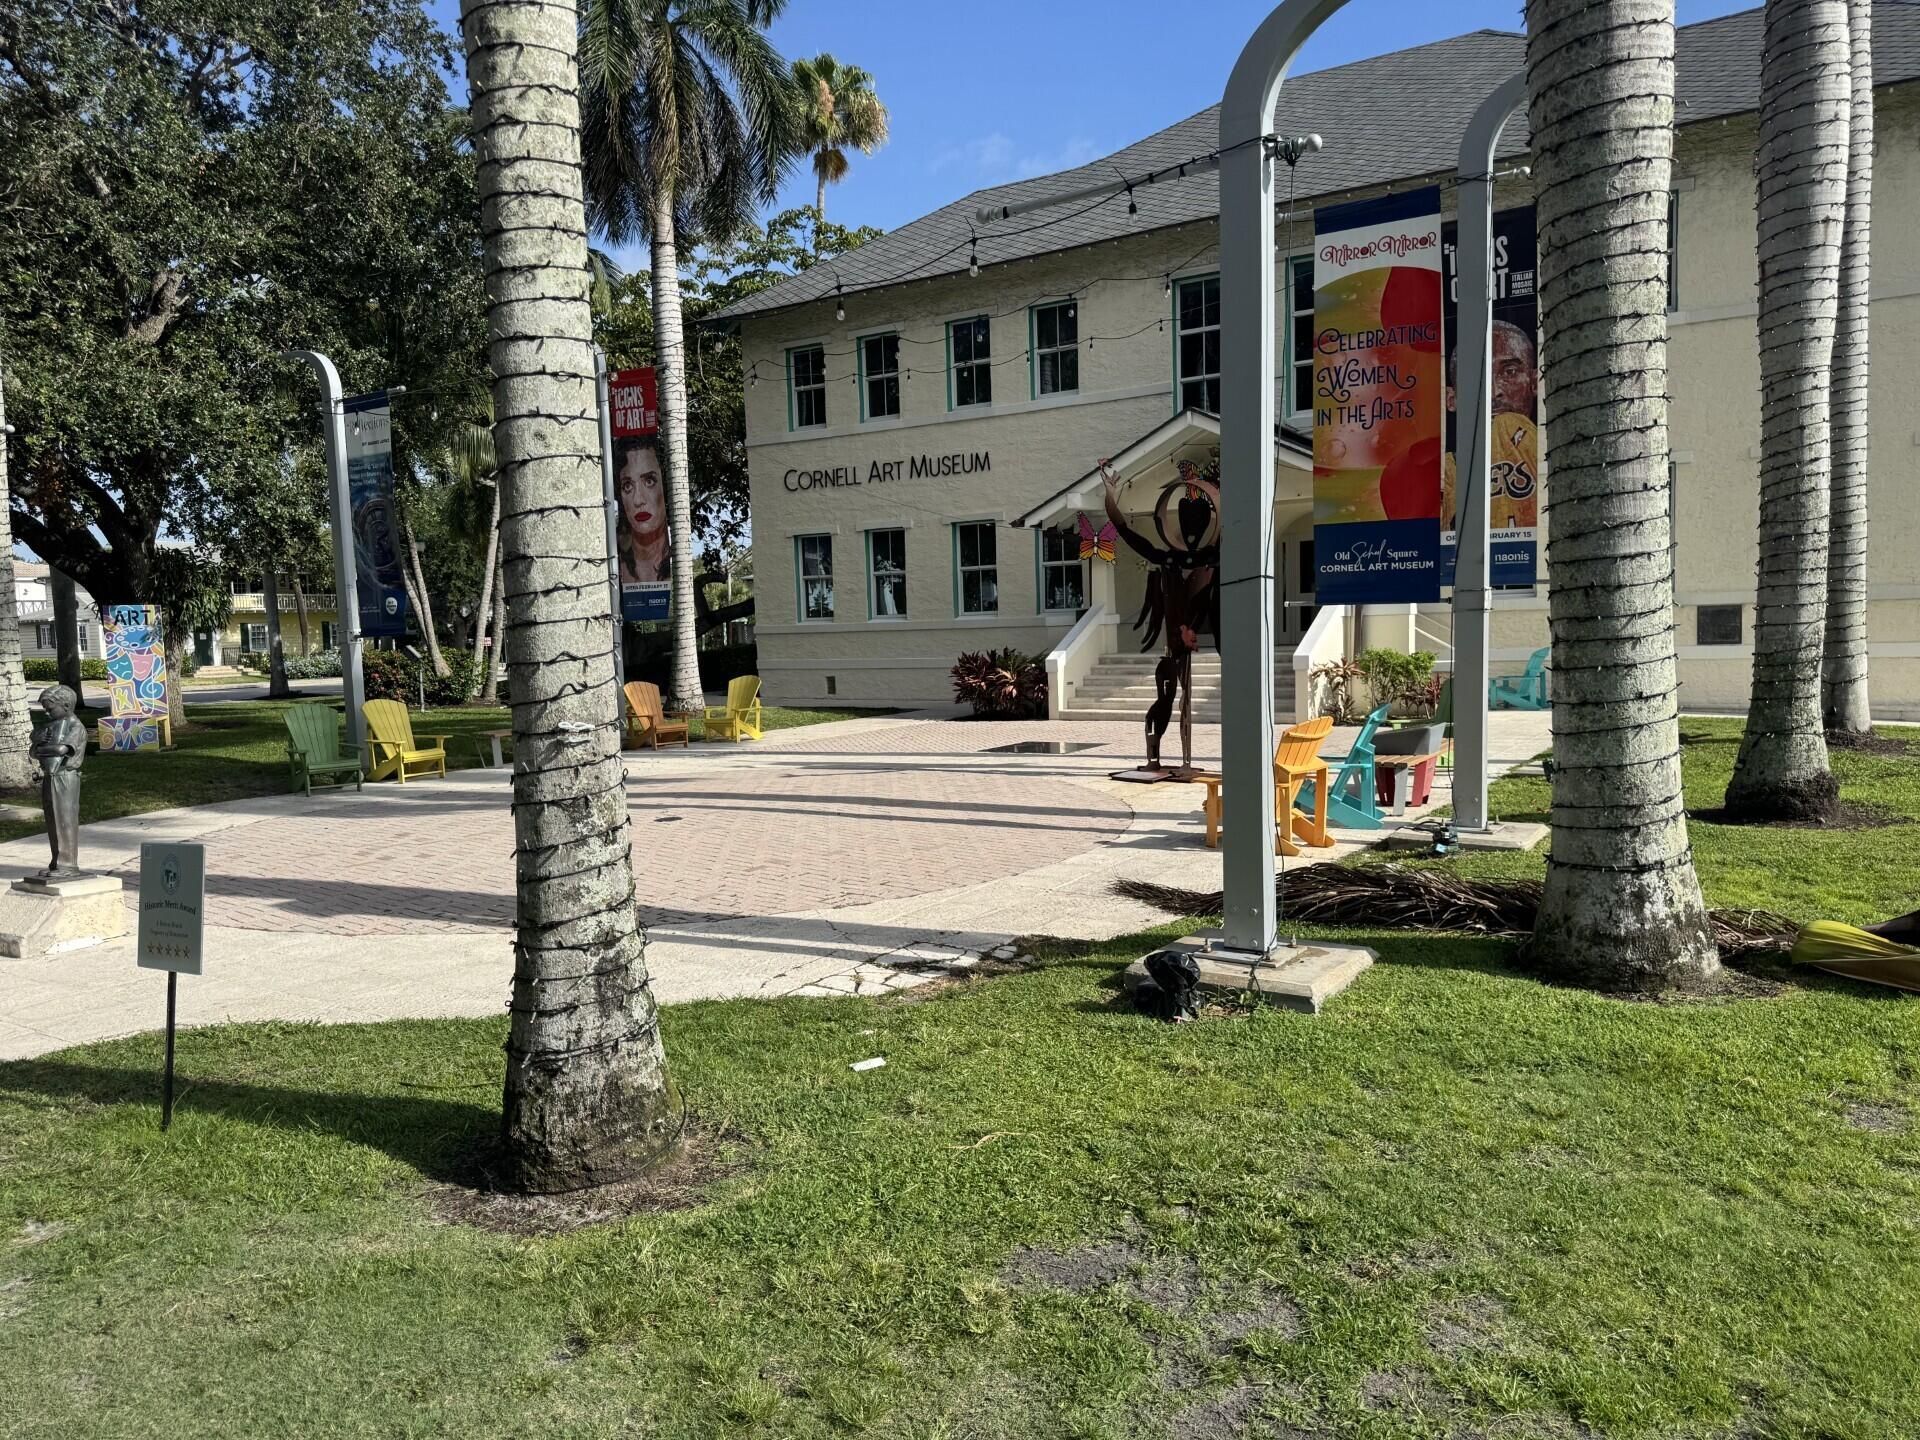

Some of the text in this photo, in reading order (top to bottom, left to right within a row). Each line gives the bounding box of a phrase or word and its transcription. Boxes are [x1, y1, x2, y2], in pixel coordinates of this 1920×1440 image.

[1511, 271, 1533, 282] ITALIAN
[1511, 280, 1533, 289] MOSAIC
[1318, 322, 1436, 354] CELEBRATING
[1316, 359, 1416, 403] WOMEN
[616, 410, 626, 428] OF
[626, 408, 644, 430] ART
[1317, 397, 1414, 430] IN THE ARTS
[784, 452, 991, 492] CORNELL ART MUSEUM
[1334, 551, 1350, 561] Old
[1386, 549, 1419, 560] Square
[1494, 550, 1530, 561] naonis
[1320, 561, 1434, 573] CORNELL ART MUSEUM
[114, 609, 152, 626] ART
